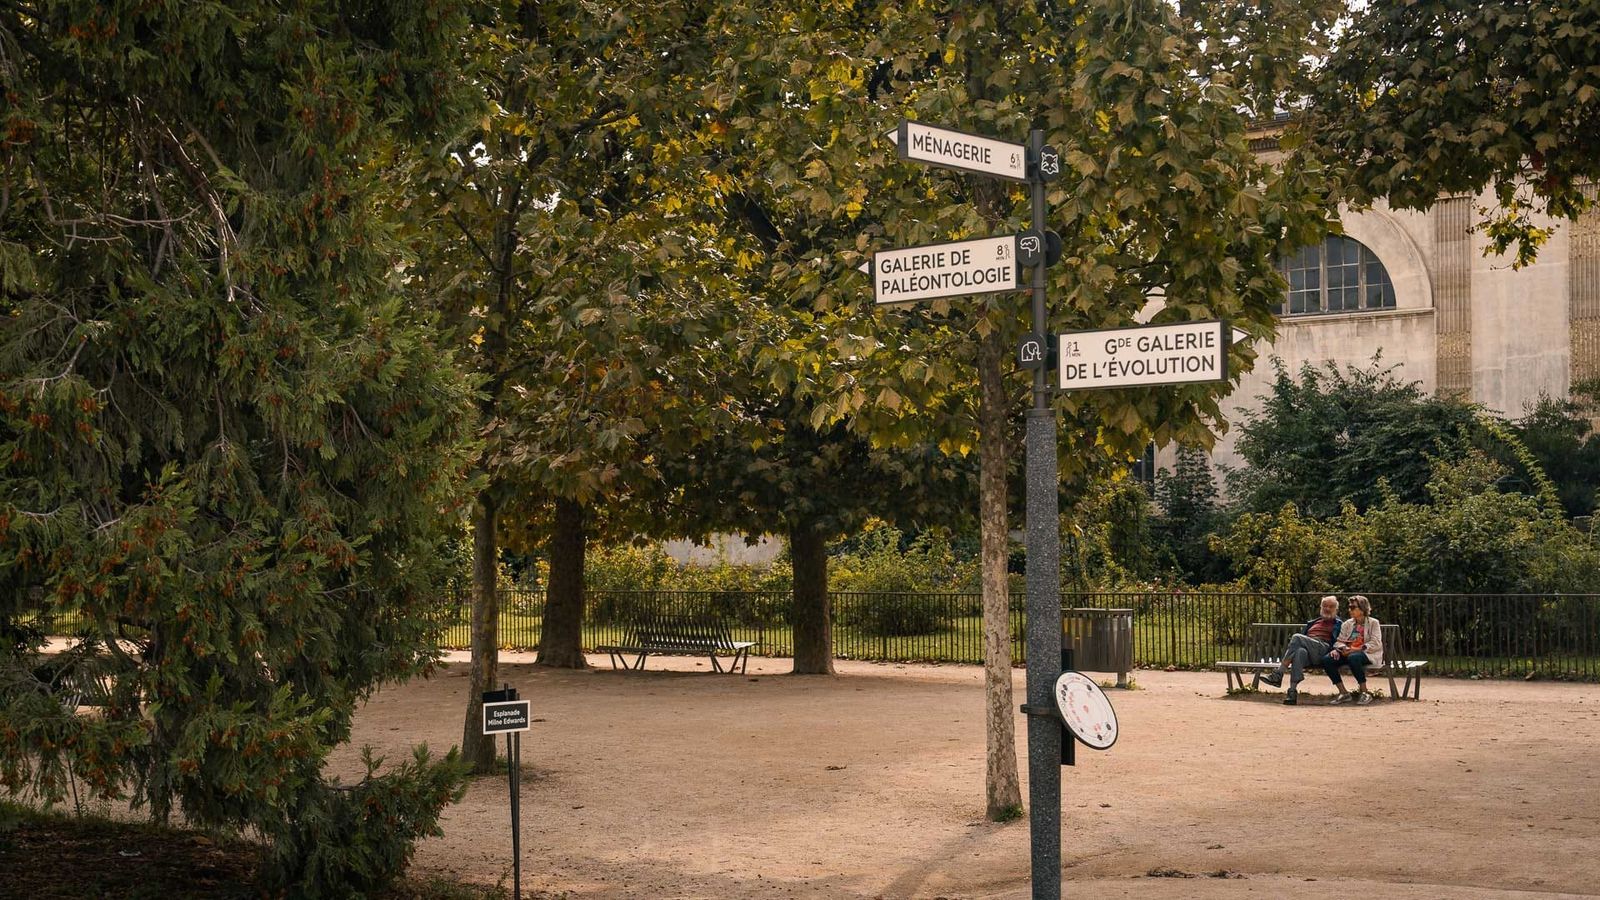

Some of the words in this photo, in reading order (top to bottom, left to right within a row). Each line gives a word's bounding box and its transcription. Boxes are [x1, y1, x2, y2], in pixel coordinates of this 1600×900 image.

[913, 132, 991, 164] MÉNAGERIE
[1010, 153, 1016, 163] 6
[996, 245, 1004, 256] 8
[881, 252, 945, 274] GALERIE
[951, 249, 971, 266] DE
[881, 266, 1011, 295] PALÉONTOLOGIE
[1073, 341, 1080, 352] 1
[1137, 331, 1215, 353] GALERIE
[1066, 363, 1087, 380] DE
[1093, 354, 1215, 378] L'ÉVOLUTION
[494, 710, 520, 718] Esplanade
[504, 717, 525, 725] Edwards
